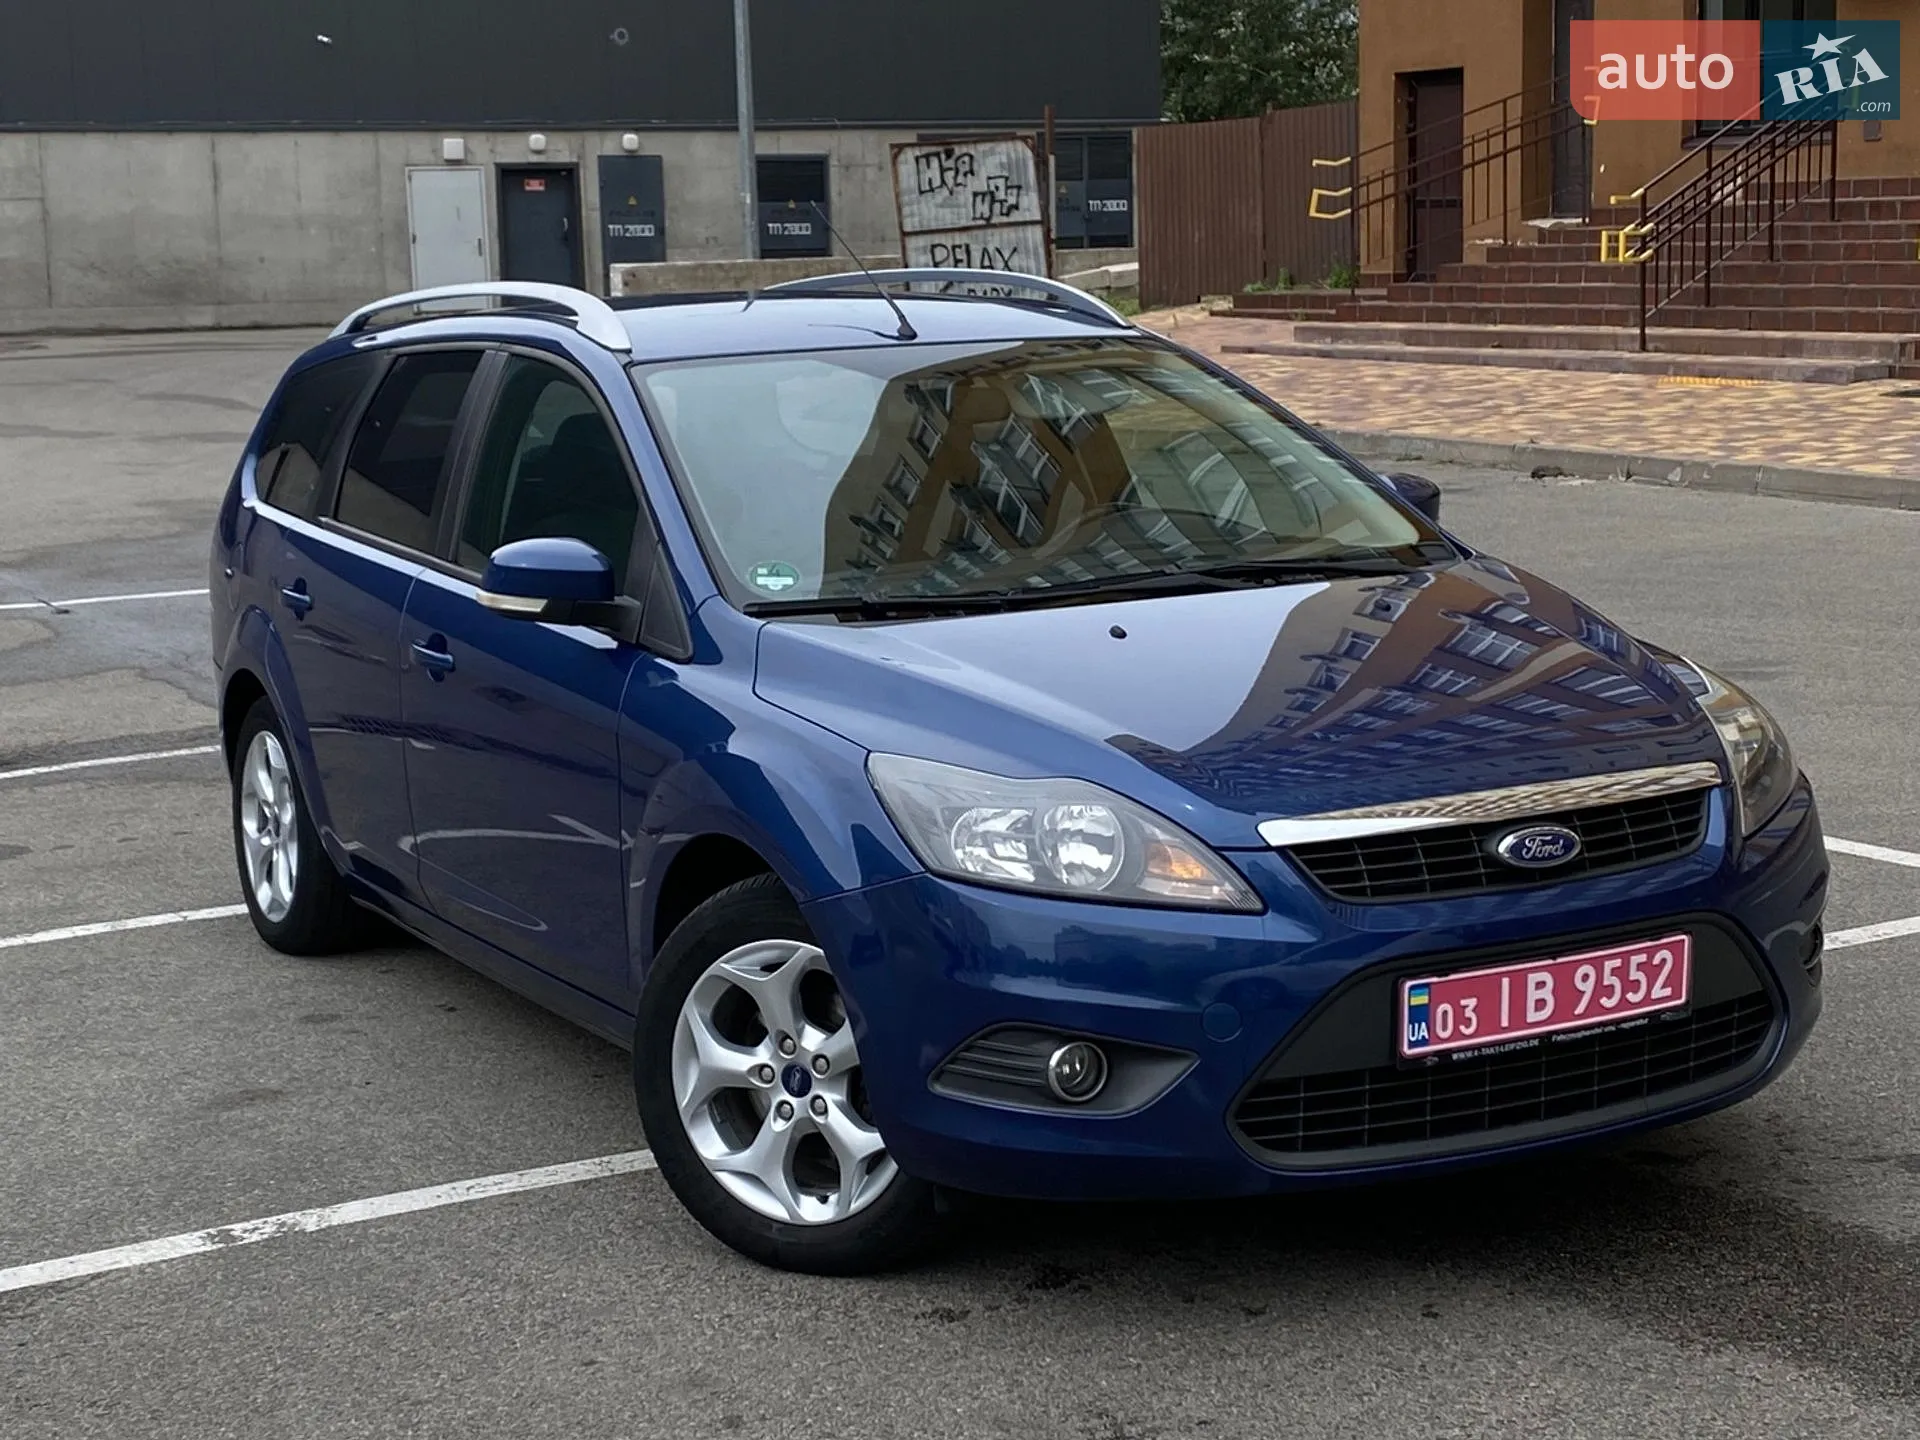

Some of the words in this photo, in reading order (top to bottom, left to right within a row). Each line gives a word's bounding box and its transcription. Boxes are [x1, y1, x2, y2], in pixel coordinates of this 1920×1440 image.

[1521, 835, 1565, 859] Ford
[1435, 997, 1479, 1040] 03
[1573, 949, 1674, 1016] 9552
[1409, 1021, 1429, 1041] UA
